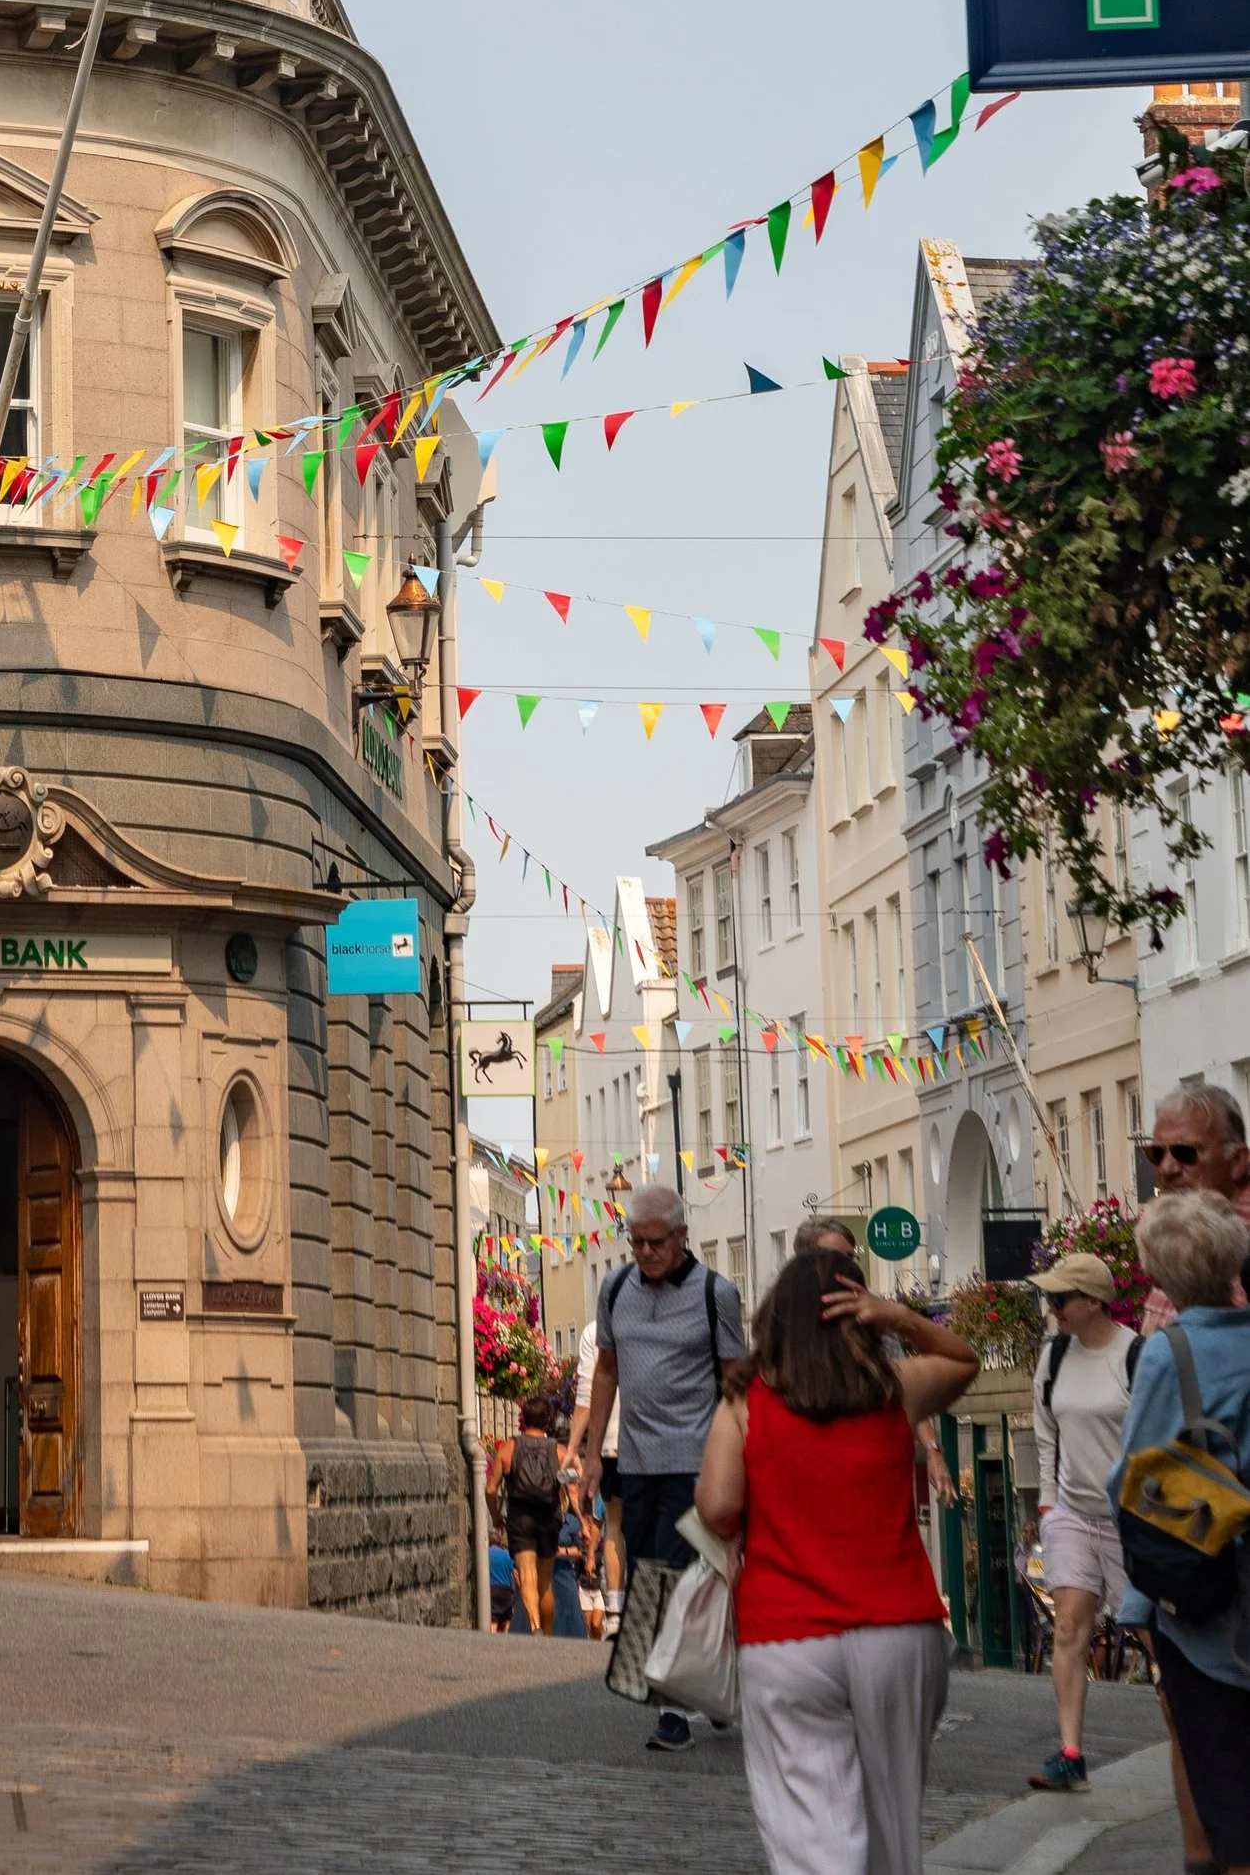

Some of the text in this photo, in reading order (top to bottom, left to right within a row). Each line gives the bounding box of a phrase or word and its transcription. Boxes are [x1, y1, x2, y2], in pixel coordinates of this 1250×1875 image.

[1, 938, 88, 969] BANK
[331, 943, 391, 955] blackhorse
[143, 1292, 181, 1301] LLOYDS BANK
